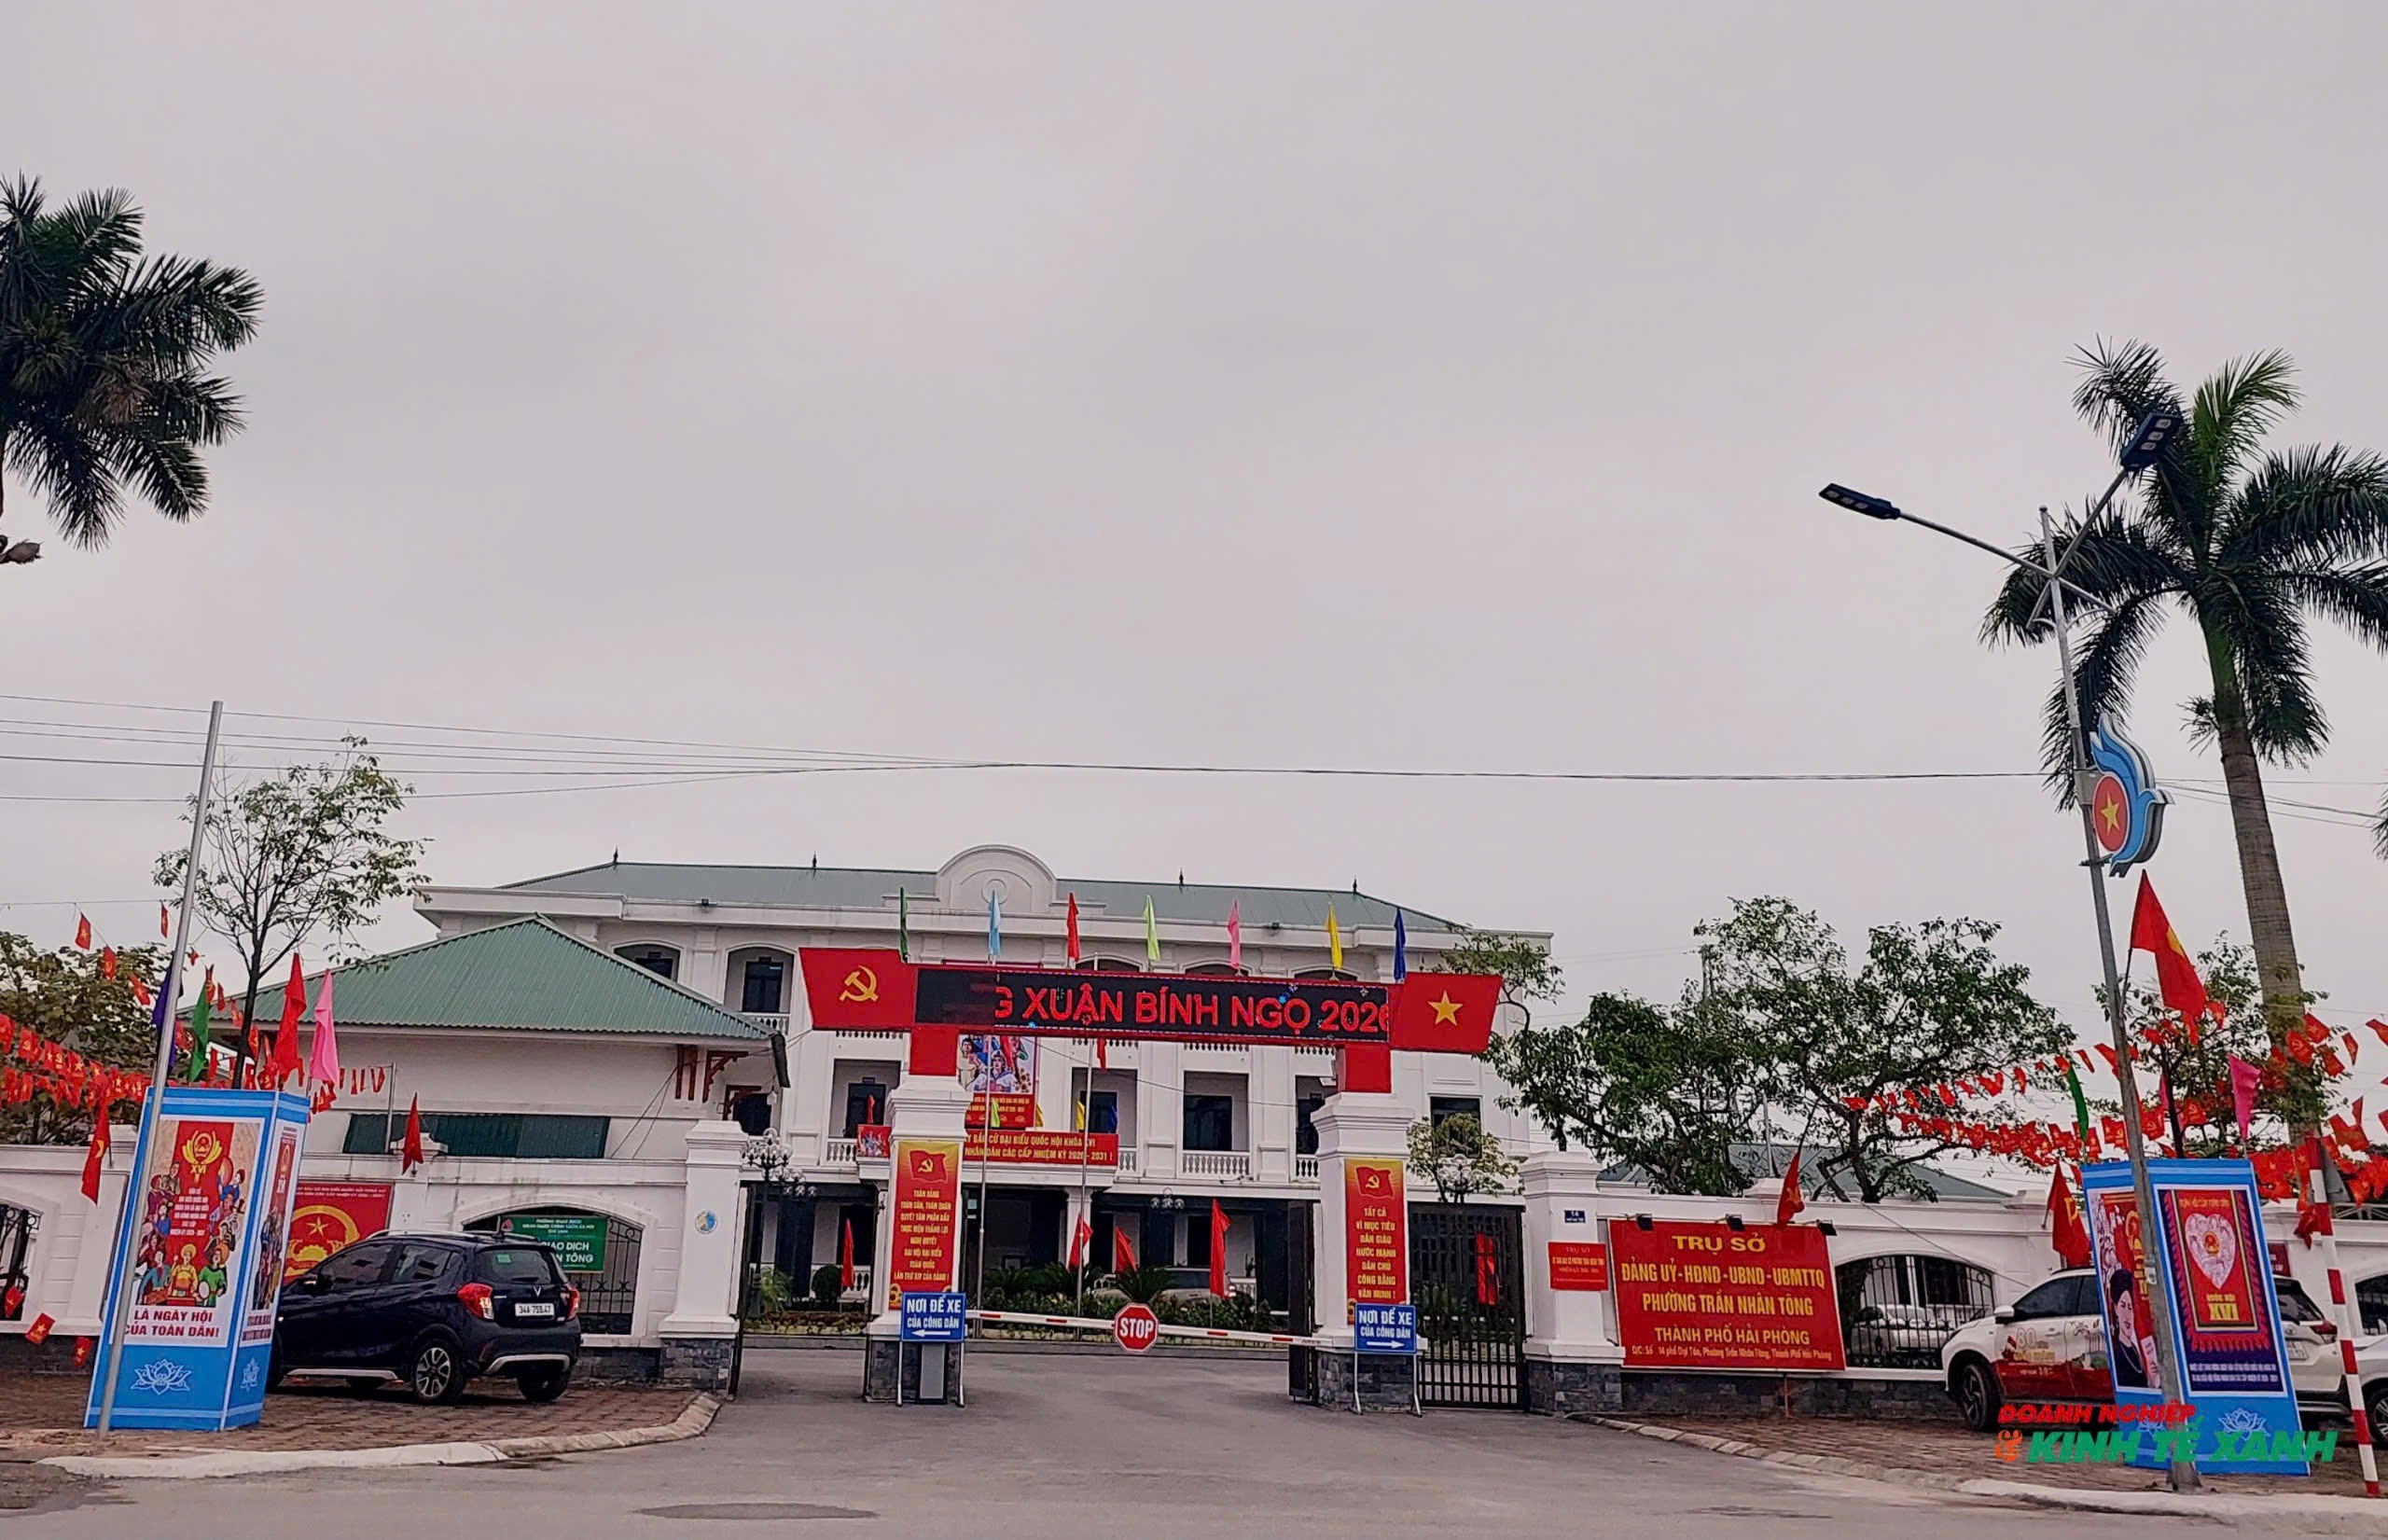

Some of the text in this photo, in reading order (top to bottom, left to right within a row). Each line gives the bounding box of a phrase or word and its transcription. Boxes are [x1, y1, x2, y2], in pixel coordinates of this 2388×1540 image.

[1022, 983, 1121, 1023] XUÂN
[1135, 987, 1218, 1025] BÍNH
[1232, 995, 1310, 1034] NGỌ
[1320, 1000, 1389, 1034] 2026
[1031, 1133, 1048, 1145] QUỐC
[1050, 1136, 1062, 1147] HỘI
[1003, 1147, 1016, 1158] CÁC
[1091, 1152, 1107, 1160] 2031
[1364, 1205, 1386, 1216] TẤT CẢ
[1356, 1220, 1363, 1229] VÌ
[1381, 1221, 1395, 1230] TIÊU
[566, 1242, 590, 1251] DỊCH
[1672, 1232, 1766, 1256] TRỤ SỞ
[566, 1253, 593, 1263] TÔNG
[1621, 1256, 1658, 1282] ĐẢNG
[1357, 1274, 1376, 1285] CÔNG
[907, 1294, 962, 1313] NƠI ĐỂ XE
[1643, 1289, 1813, 1316] PHƯỜNG TRẦN NHÂN TÔNG
[134, 1309, 213, 1324] LÀ NGÀY HỘI
[1358, 1307, 1412, 1325] NƠI ĐỂ XE
[2208, 1303, 2239, 1322] XVI
[907, 1313, 959, 1329] CỦA CÔNG DÂN
[1120, 1317, 1154, 1339] STOP
[151, 1324, 185, 1337] TOÀN
[188, 1325, 219, 1338] DÂN!
[1360, 1324, 1411, 1339] CỦA CÔNG DÂN
[1655, 1323, 1810, 1345] THÀNH PHỐ HẢI PHÒNG
[2016, 1327, 2036, 1350] 80
